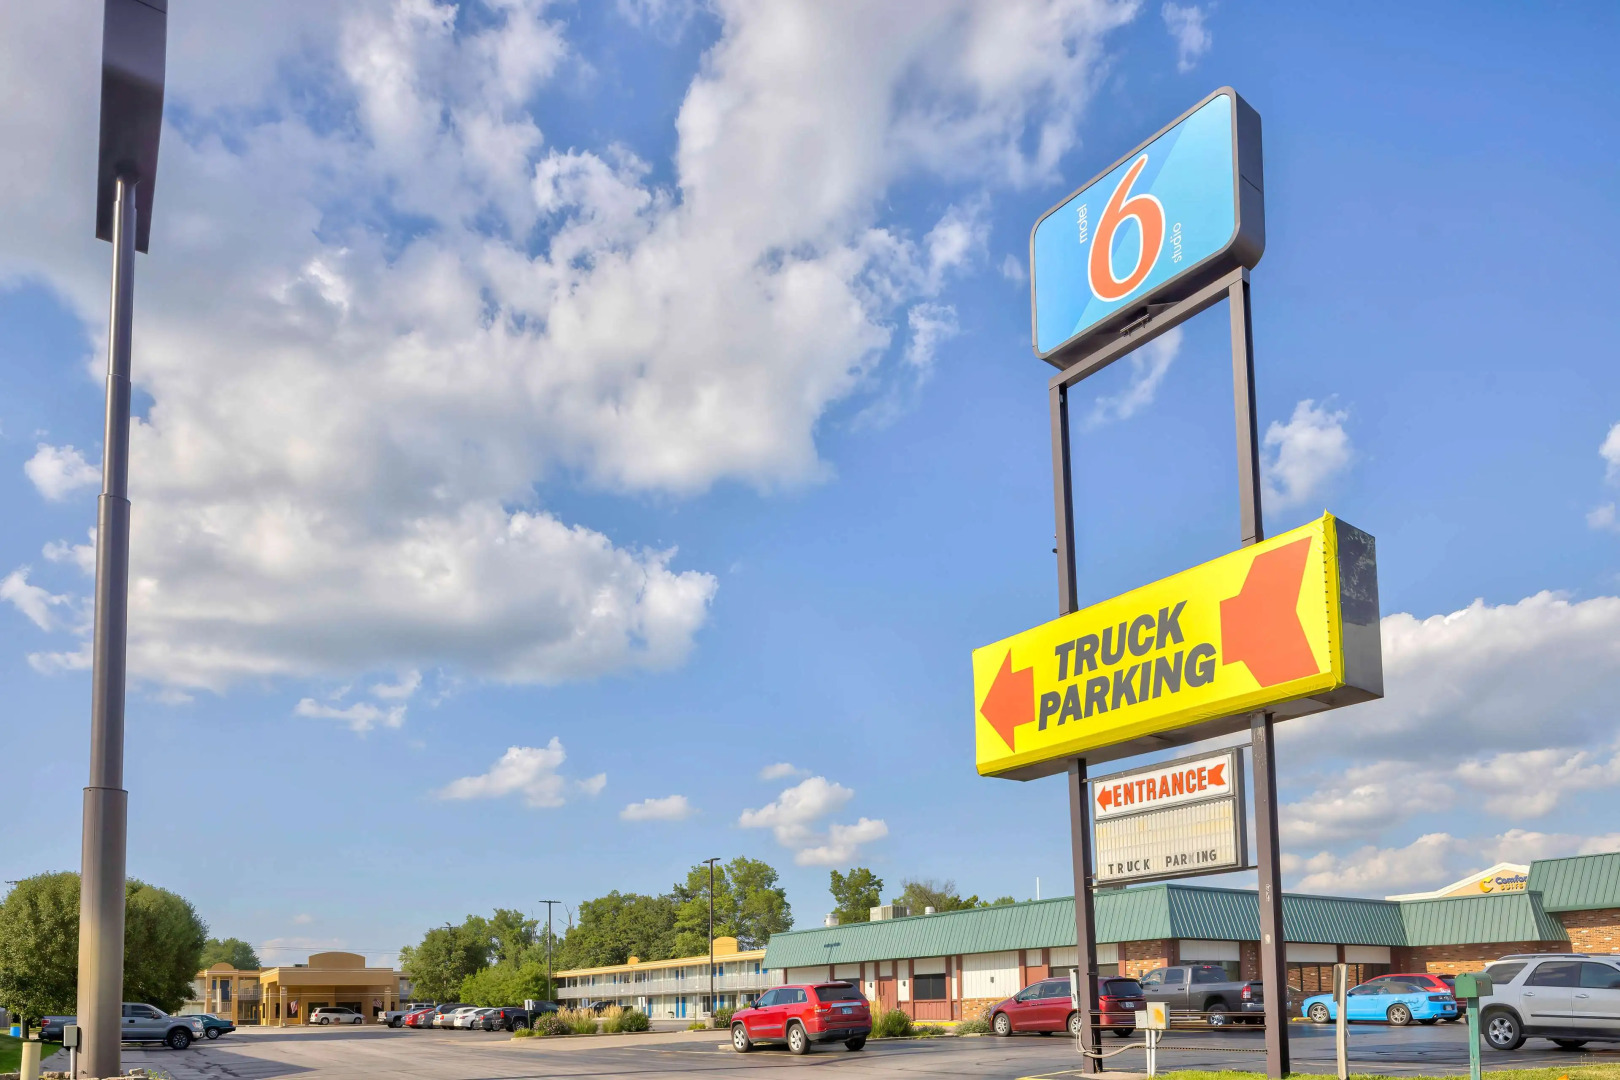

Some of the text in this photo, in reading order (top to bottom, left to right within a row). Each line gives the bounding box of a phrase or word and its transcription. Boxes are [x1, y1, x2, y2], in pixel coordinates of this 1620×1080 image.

[1076, 153, 1182, 302] motel 6 studio
[1055, 600, 1187, 681] TRUCK
[1038, 643, 1216, 731] PARKING
[1113, 767, 1207, 807] ENTRANCE
[1108, 850, 1217, 874] TRUCK PARKING
[1495, 874, 1528, 885] Comfor
